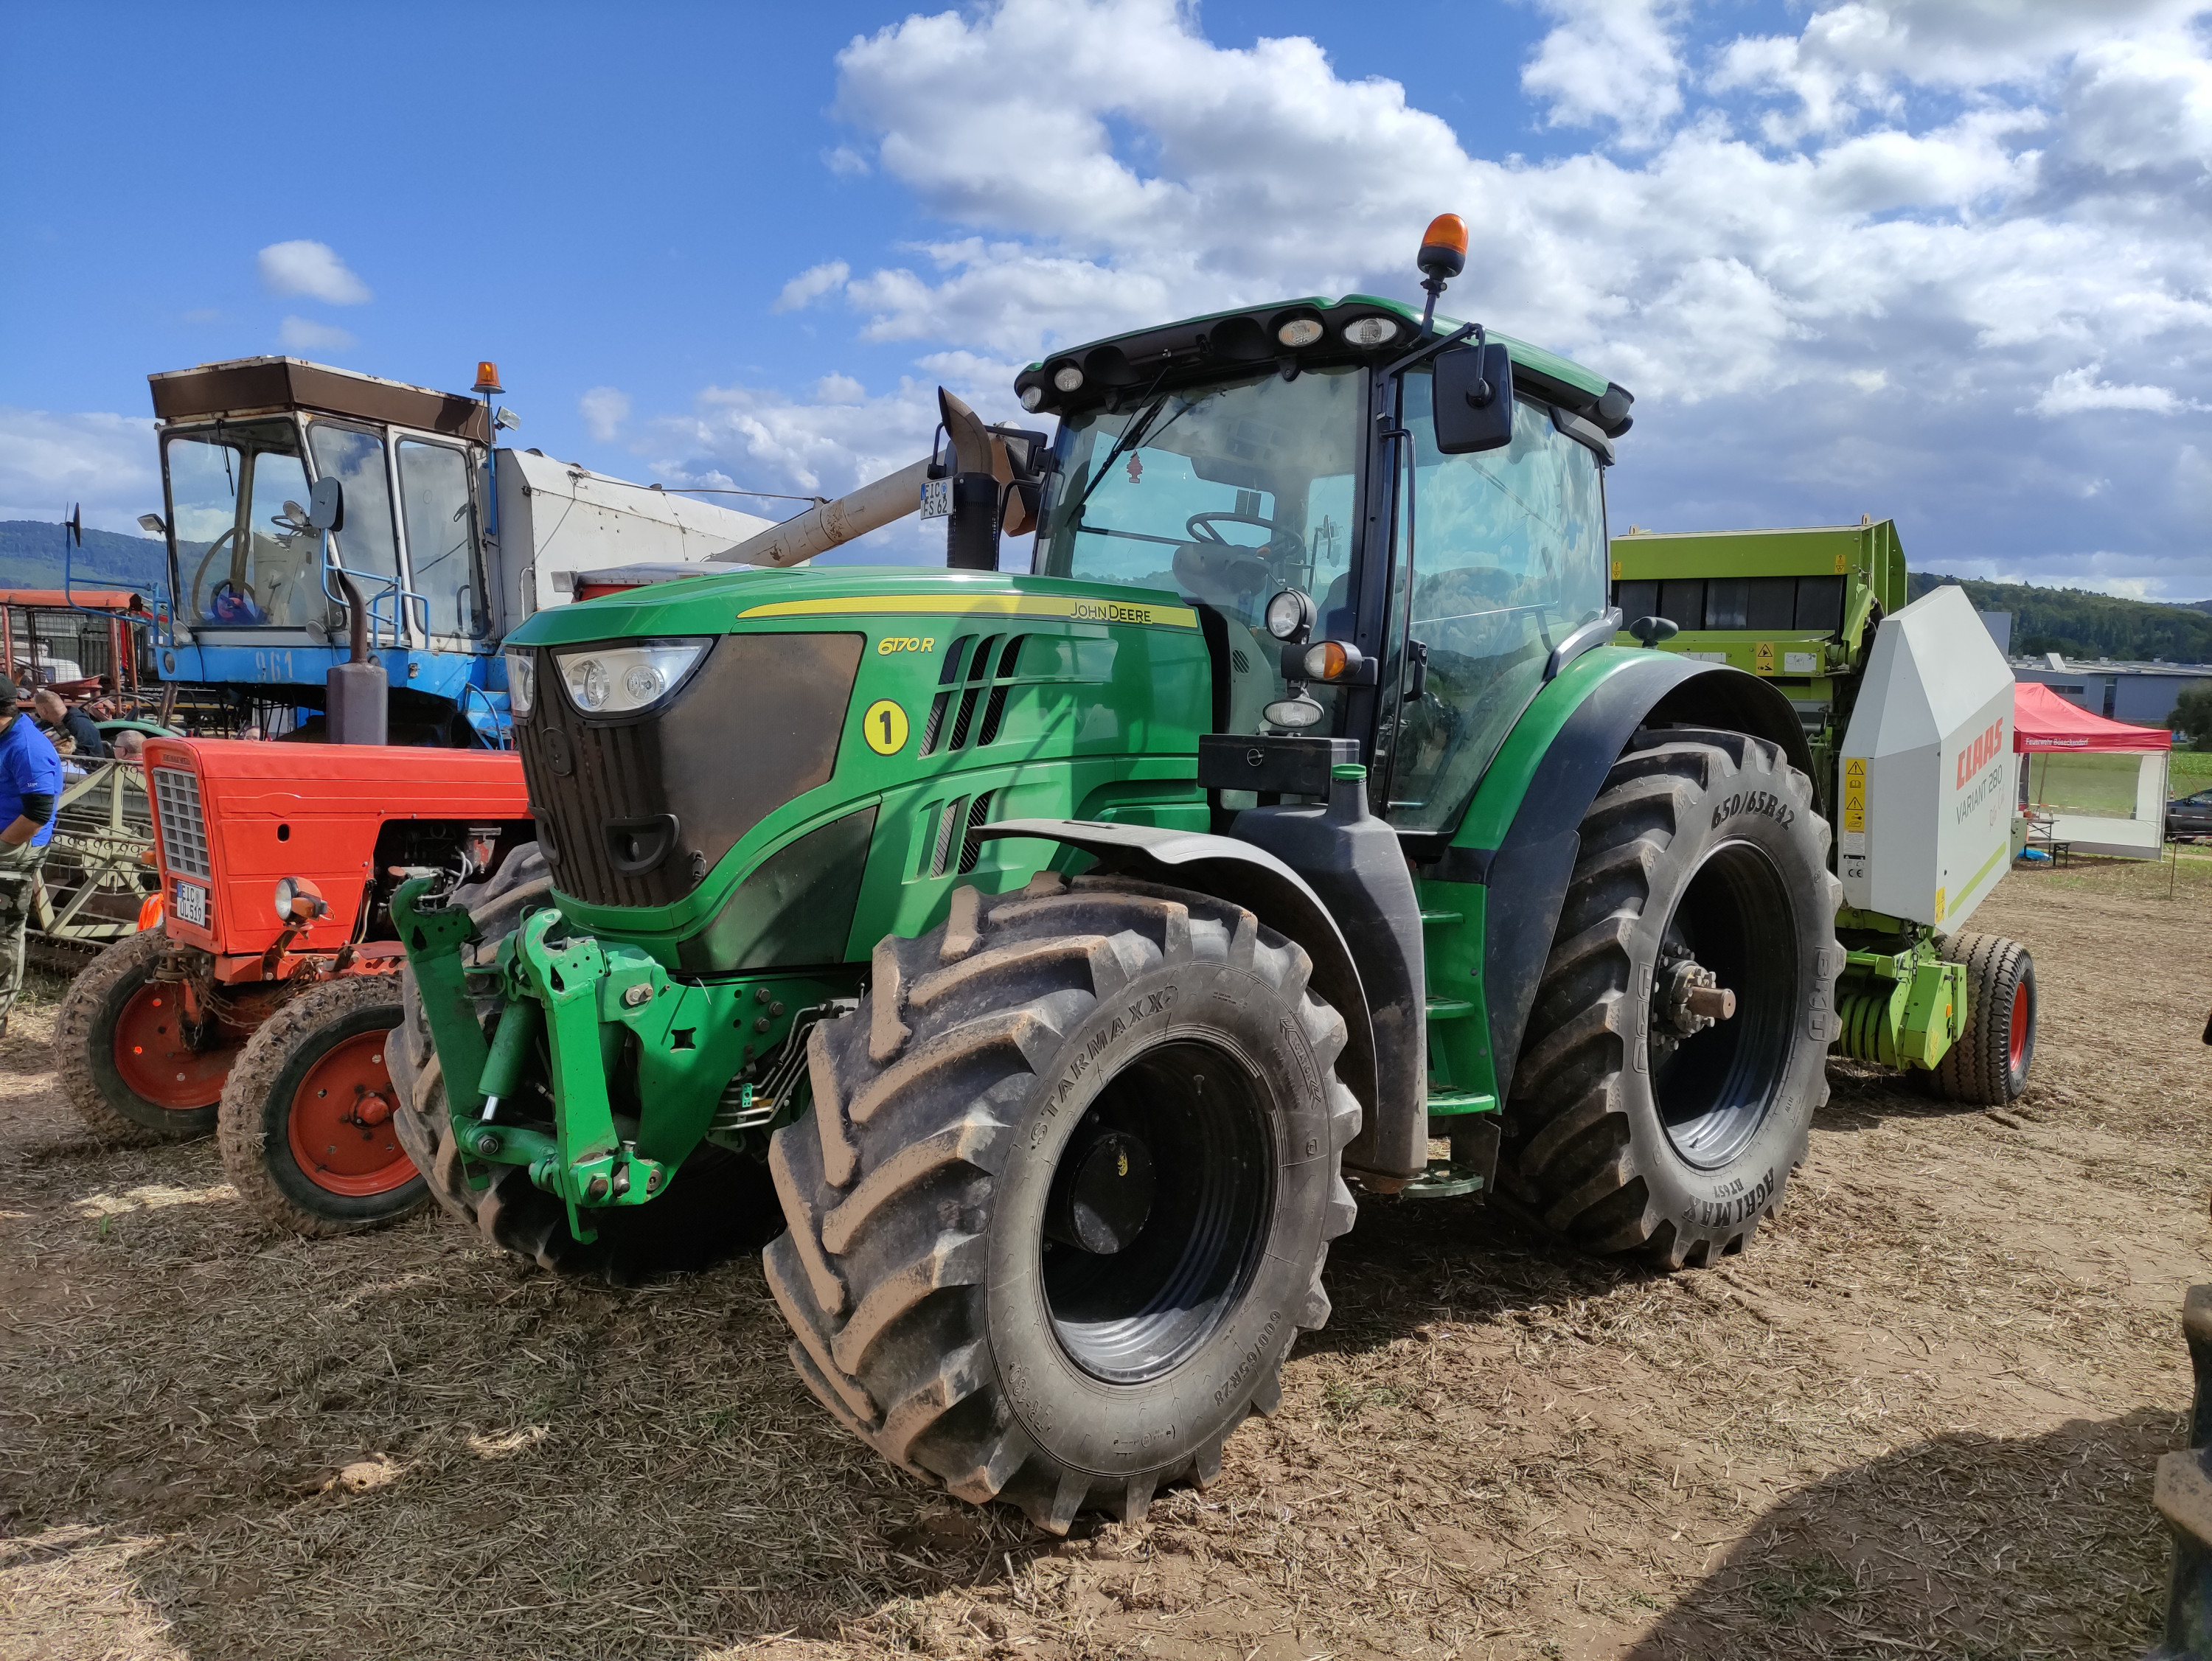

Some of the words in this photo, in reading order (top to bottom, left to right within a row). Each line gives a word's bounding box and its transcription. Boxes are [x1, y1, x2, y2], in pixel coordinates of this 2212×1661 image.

[924, 497, 934, 517] FS
[937, 498, 947, 515] 62
[925, 482, 940, 499] EIC
[1071, 602, 1107, 619] JOHN
[1109, 605, 1152, 622] DEERE
[879, 710, 891, 745] 1
[2025, 737, 2053, 745] Feuerwehr
[2053, 737, 2089, 746] Böseckendorf
[1956, 717, 2003, 791] CLAAS
[1711, 790, 1795, 832] 650/65R42
[1956, 779, 1987, 825] VARIANT
[1989, 764, 2003, 794] 280
[181, 885, 195, 903] EIC
[189, 904, 202, 922] 519
[1809, 946, 1832, 1042] BKT
[1030, 990, 1166, 1146] STARMAXX
[1682, 1166, 1774, 1229] AGRIMAX
[1214, 1310, 1281, 1407] 600/65R28
[1008, 1365, 1054, 1434] TR-130
